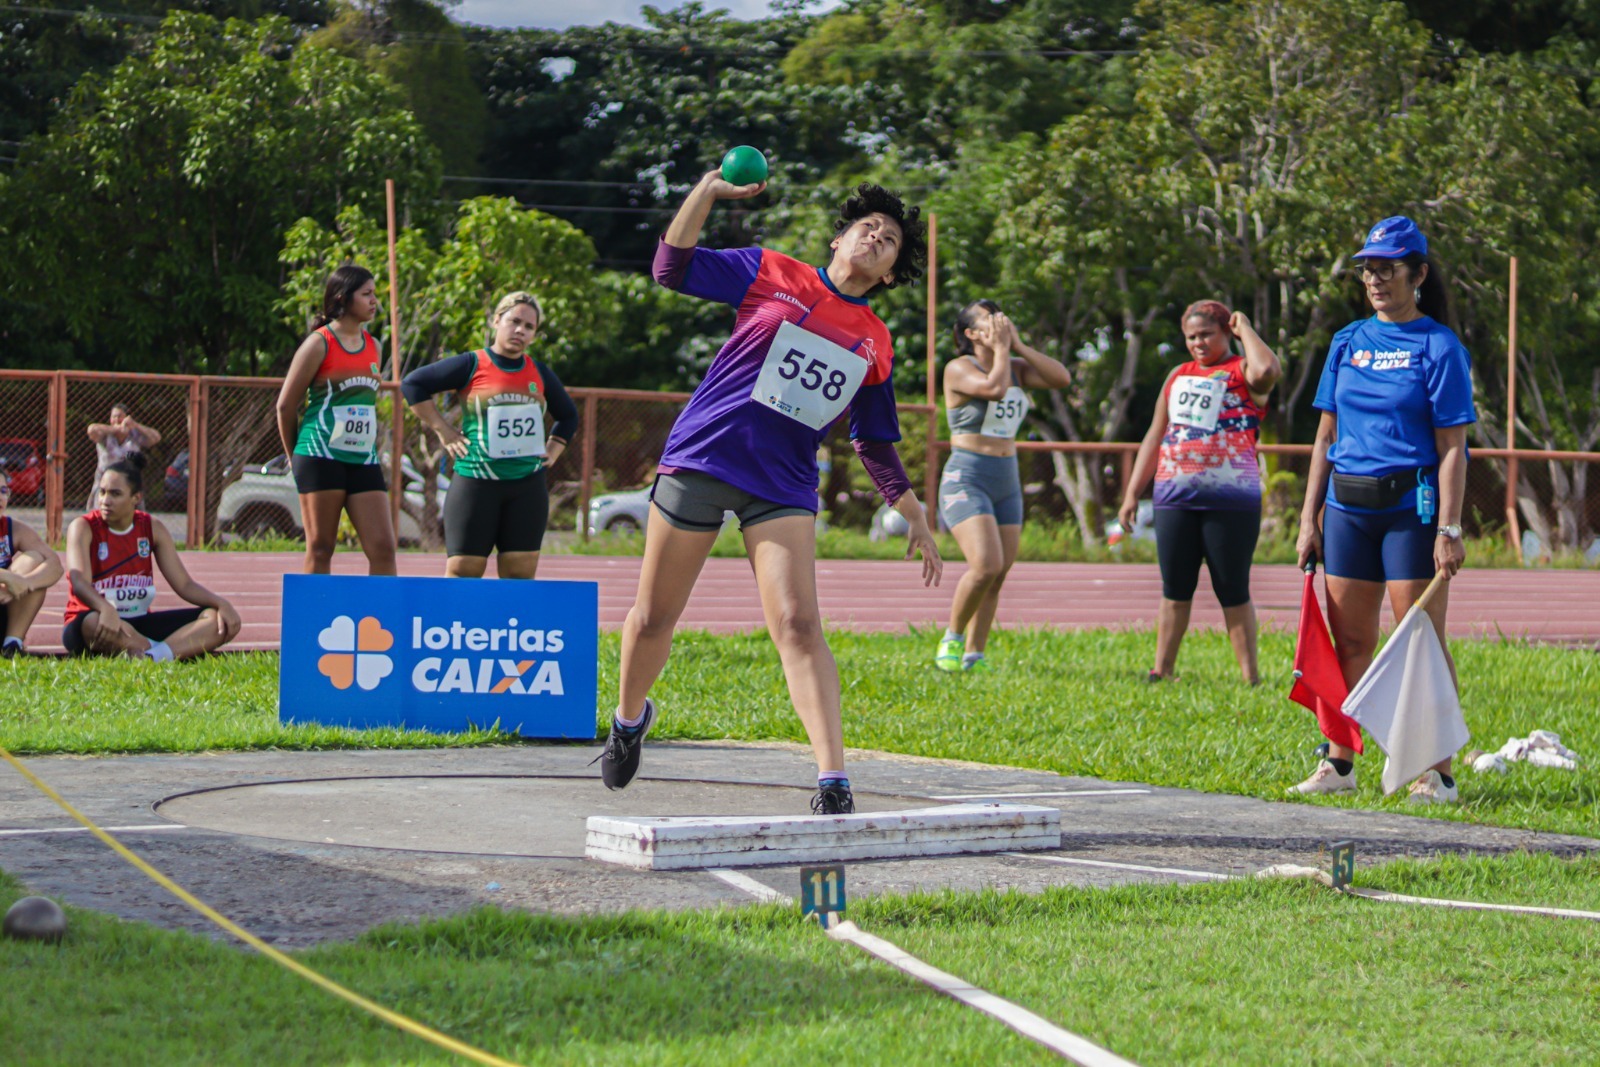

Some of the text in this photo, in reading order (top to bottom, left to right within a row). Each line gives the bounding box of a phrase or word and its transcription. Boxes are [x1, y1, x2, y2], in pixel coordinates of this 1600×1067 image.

[1372, 359, 1410, 370] CAIXA
[1374, 348, 1411, 360] loterias
[778, 348, 847, 401] 558
[995, 400, 1022, 419] 551
[1178, 391, 1212, 410] 078
[345, 419, 371, 435] 081
[497, 417, 536, 439] 552
[412, 616, 565, 653] loterias
[412, 657, 565, 695] CAIXA
[1338, 848, 1349, 878] 5
[810, 871, 838, 906] 11
